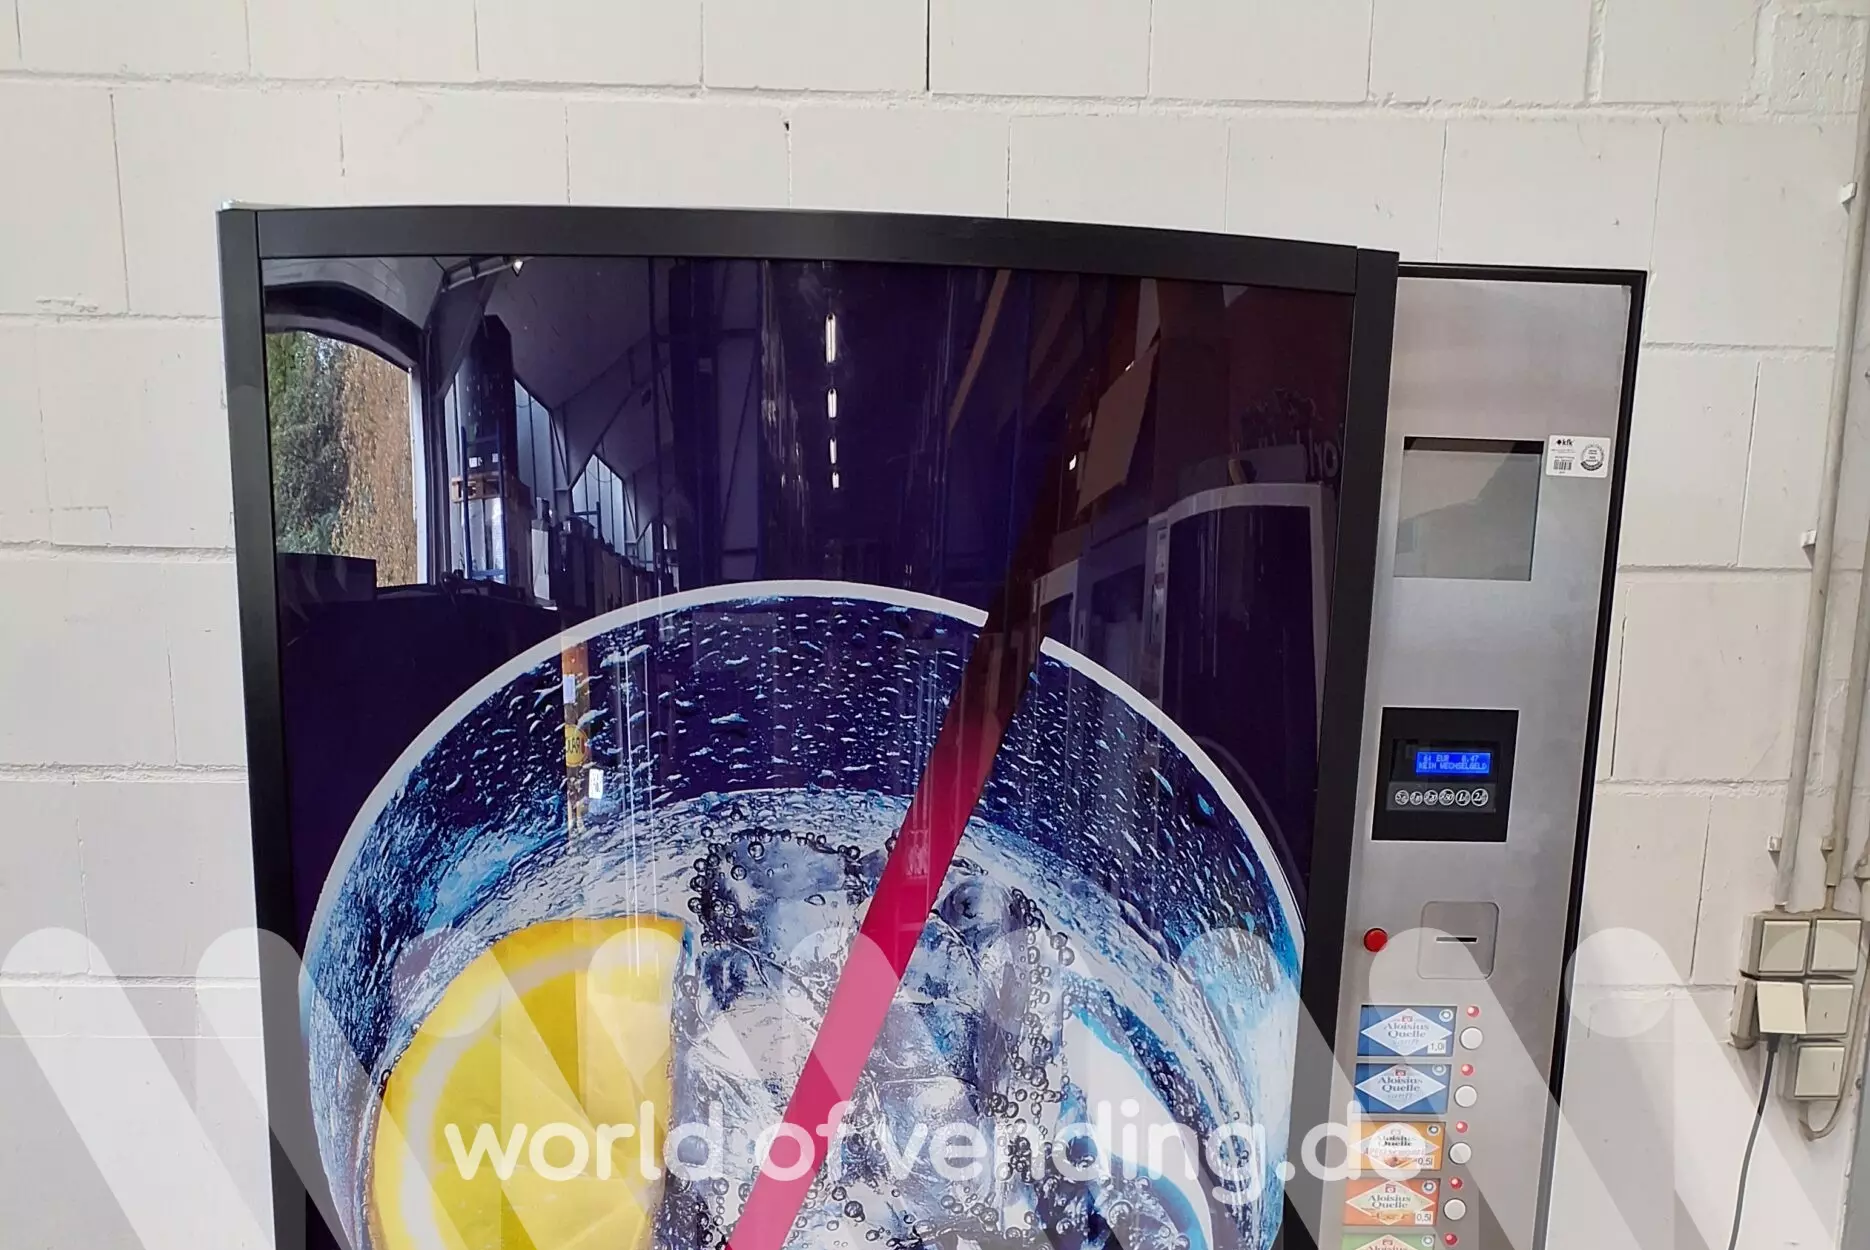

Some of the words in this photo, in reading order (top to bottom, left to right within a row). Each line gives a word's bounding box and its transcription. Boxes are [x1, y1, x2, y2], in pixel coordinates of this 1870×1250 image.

[1384, 1022, 1429, 1030] Aloisius
[1388, 1030, 1426, 1038] Quelle
[1378, 1076, 1423, 1084] Aloisius
[1382, 1084, 1421, 1092] Quelle
[1368, 1194, 1411, 1202] Aloisius
[1372, 1201, 1408, 1209] Quelle
